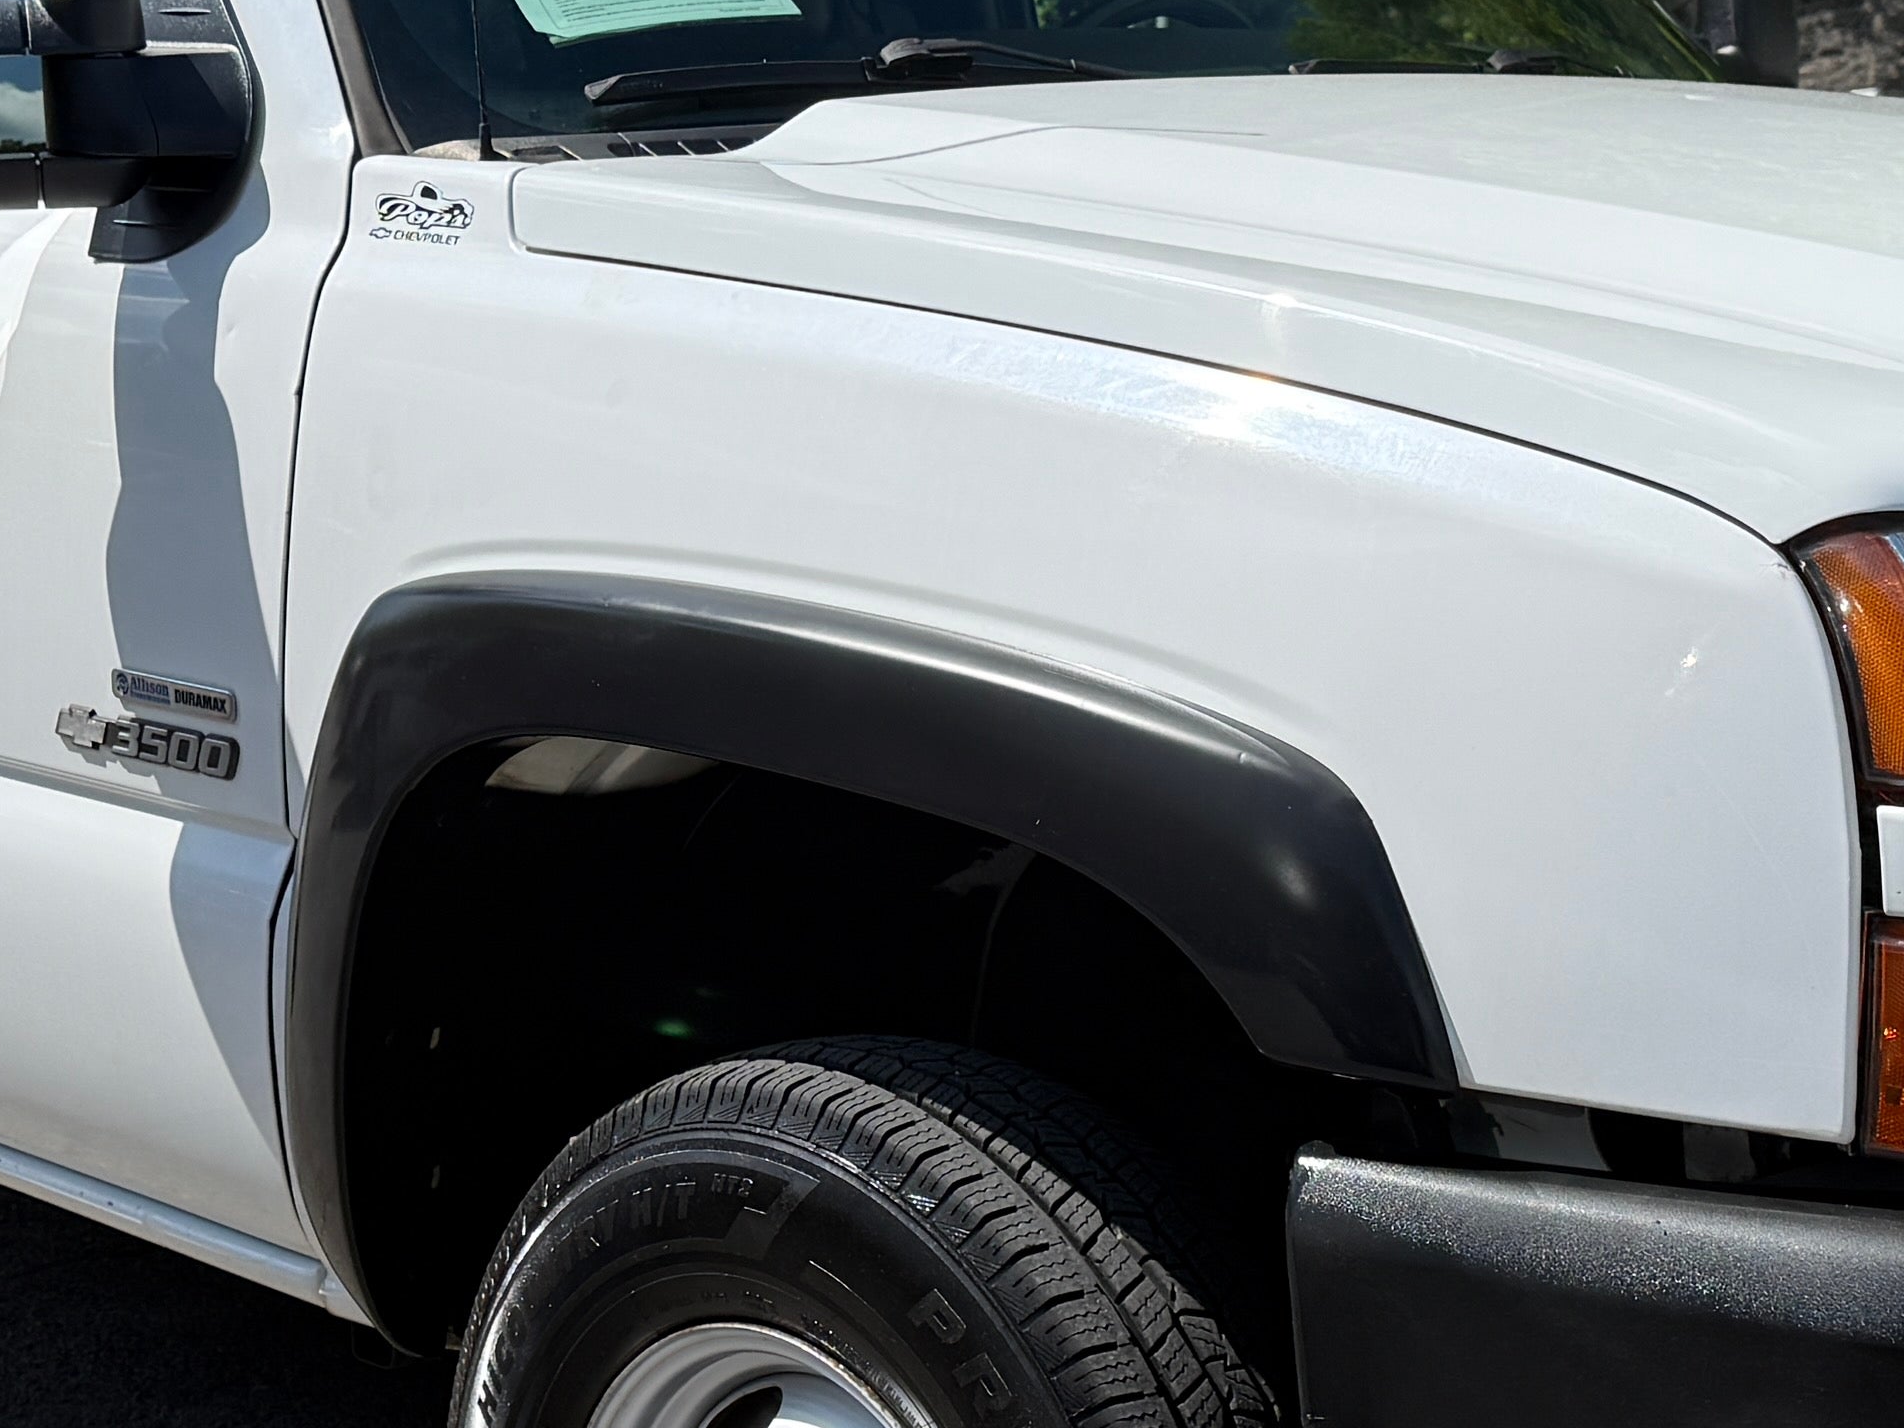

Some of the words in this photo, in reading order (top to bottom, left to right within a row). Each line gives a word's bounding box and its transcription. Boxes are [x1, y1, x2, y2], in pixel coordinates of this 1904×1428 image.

[393, 229, 461, 246] CHEVROLET
[129, 676, 170, 698] Allison
[174, 688, 228, 714] DURAMAX
[111, 718, 234, 779] 3500
